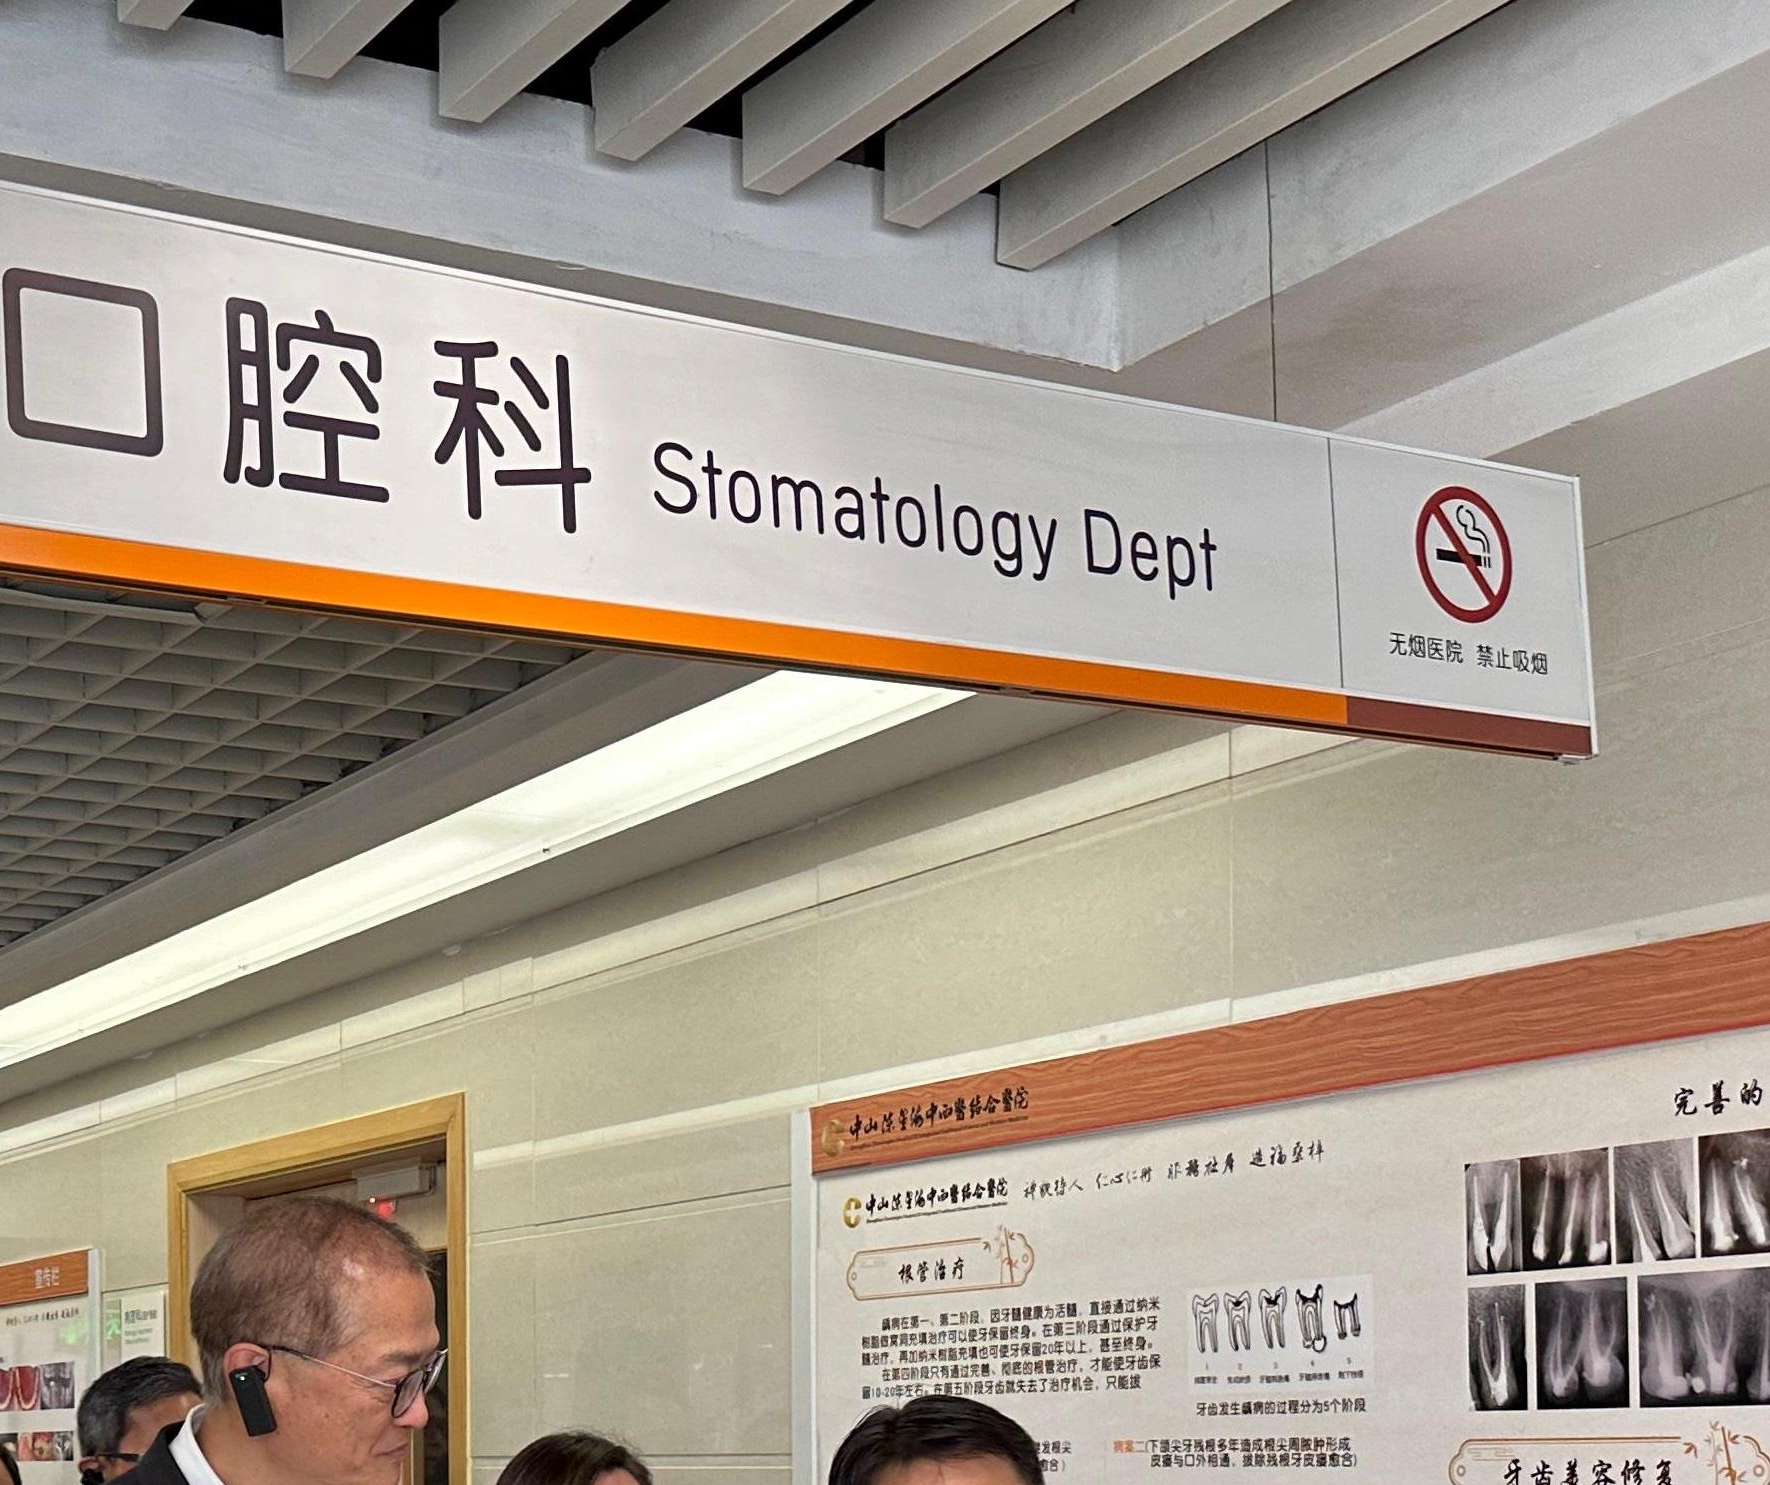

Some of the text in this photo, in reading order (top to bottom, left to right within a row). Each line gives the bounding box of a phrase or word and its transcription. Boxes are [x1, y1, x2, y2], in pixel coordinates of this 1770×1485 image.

[3, 267, 1218, 600] 口腔科 Stomatology Dept
[1389, 631, 1549, 675] 无烟医院 禁止吸烟
[1674, 1078, 1763, 1117] 完善的
[897, 1255, 967, 1285] 根管治疗
